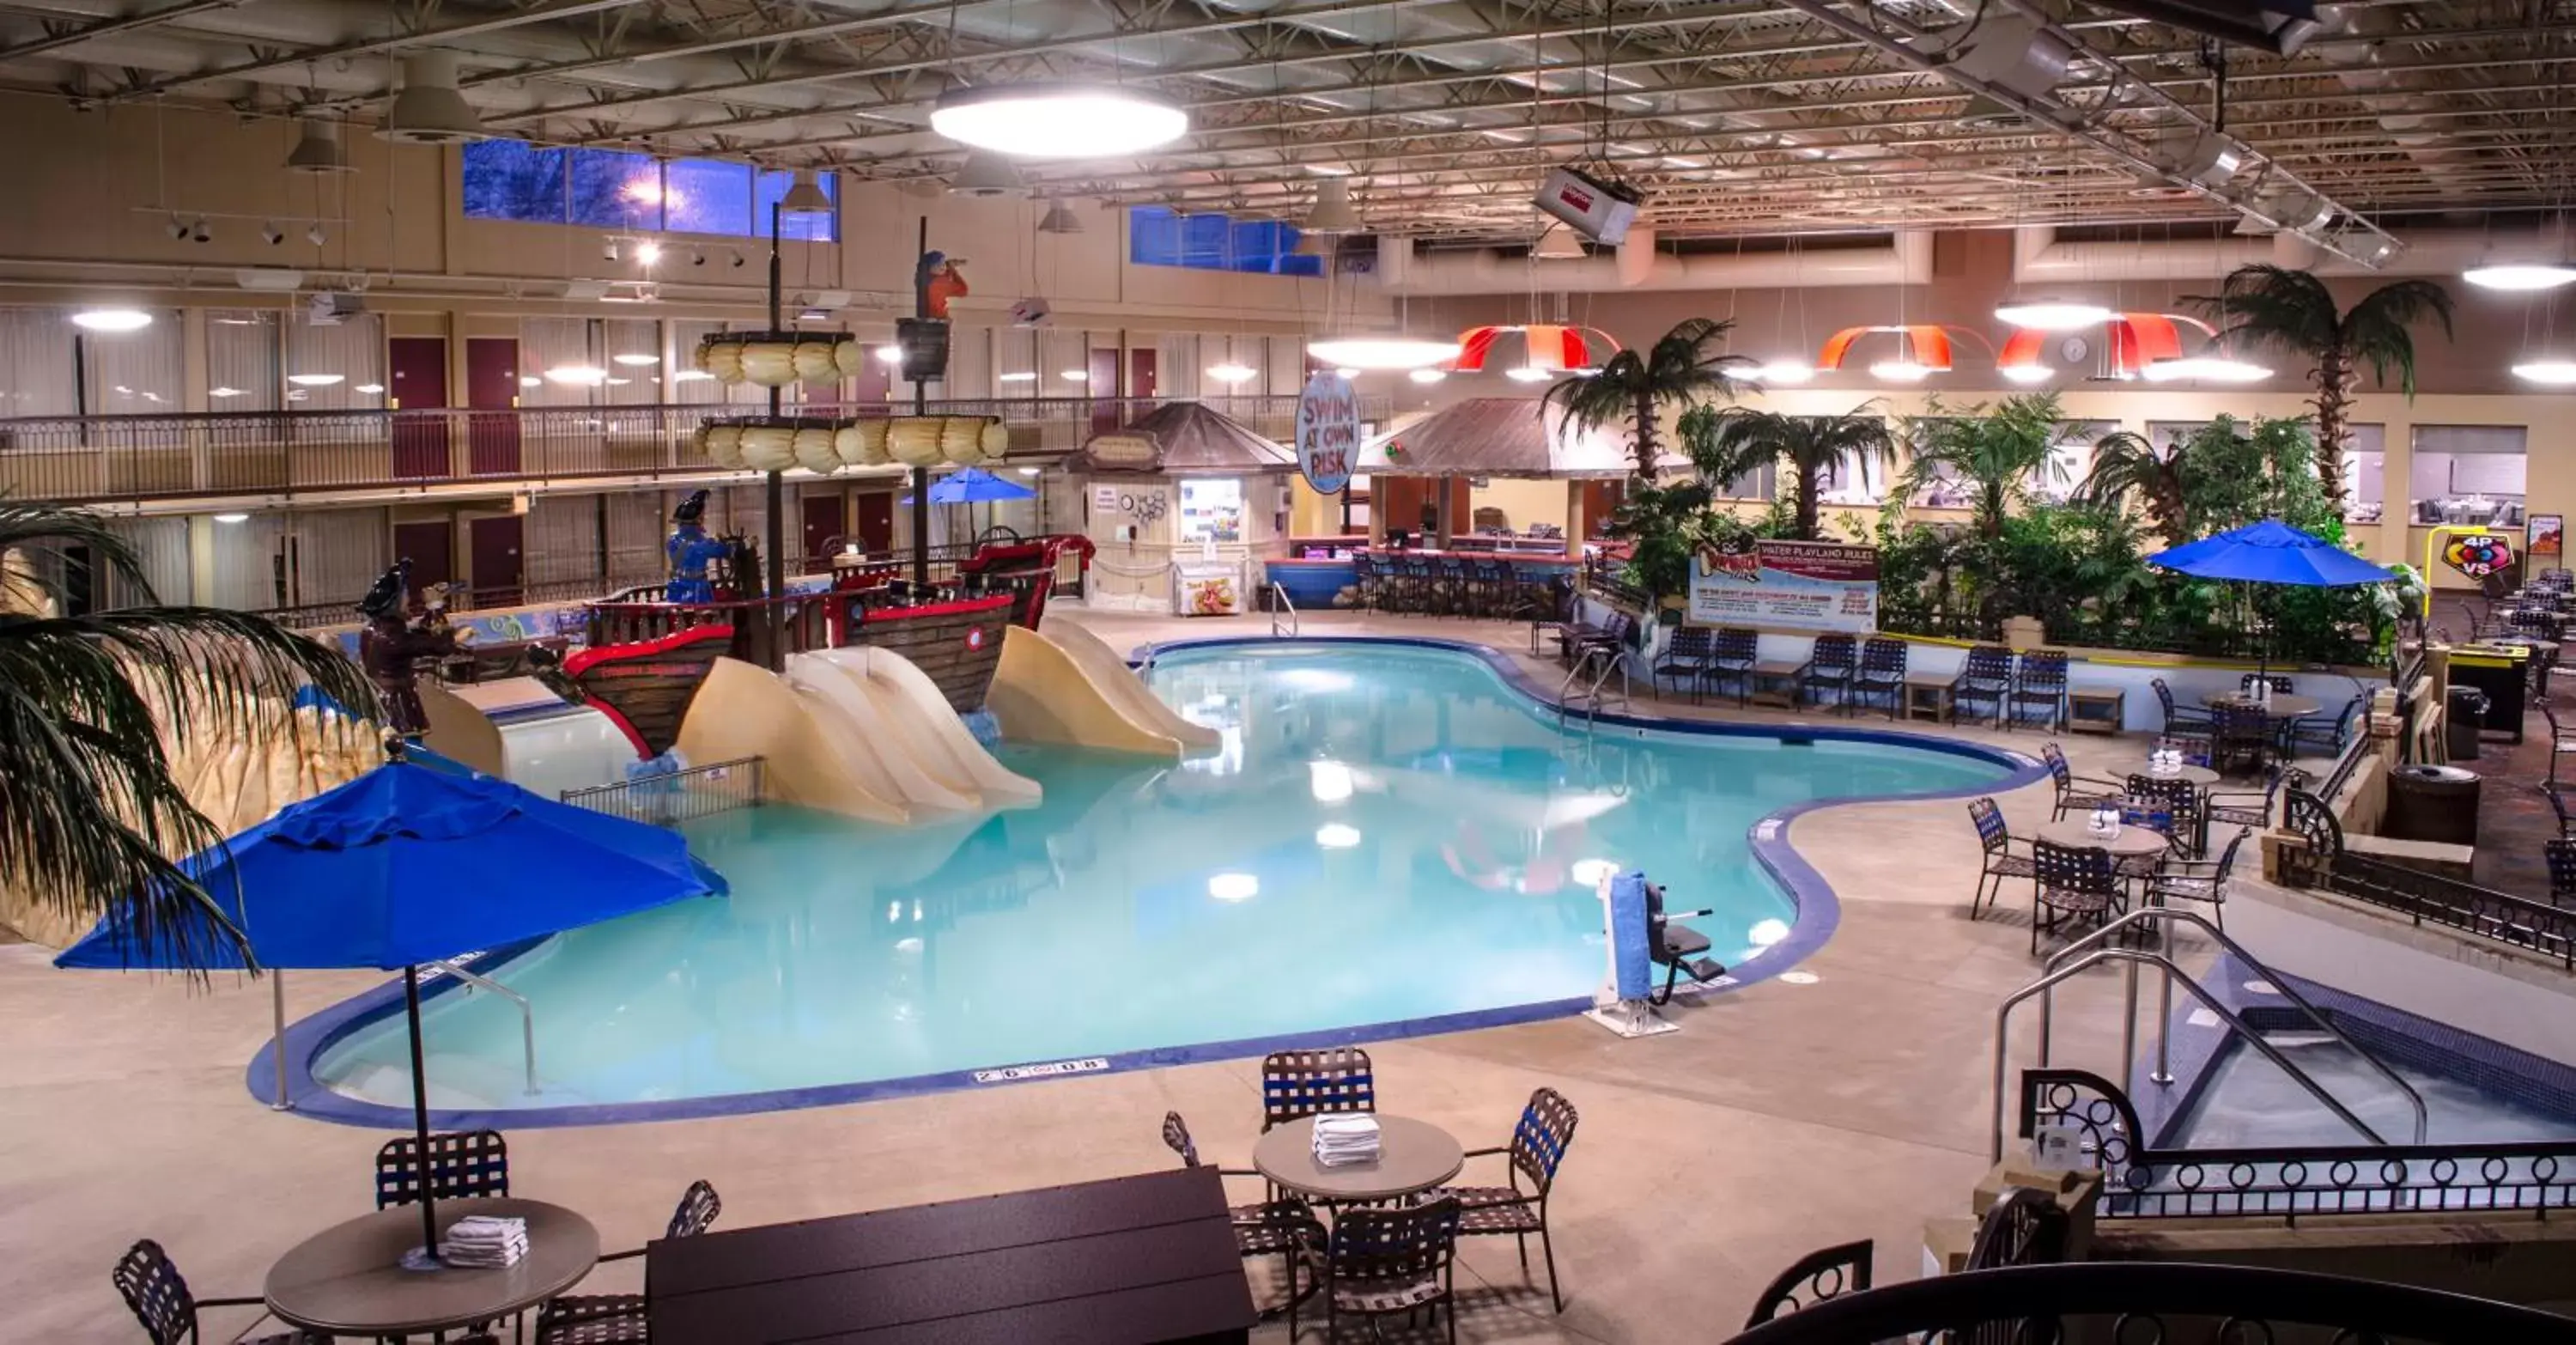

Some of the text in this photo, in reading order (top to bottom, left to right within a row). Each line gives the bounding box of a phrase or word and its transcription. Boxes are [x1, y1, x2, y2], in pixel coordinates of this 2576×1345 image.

[1303, 396, 1354, 423] SWIM
[1303, 423, 1354, 450] AT OWN
[1310, 447, 1349, 478] RISK
[1761, 545, 1874, 560] WATER PLAYLAND RULES
[2463, 563, 2491, 575] VS
